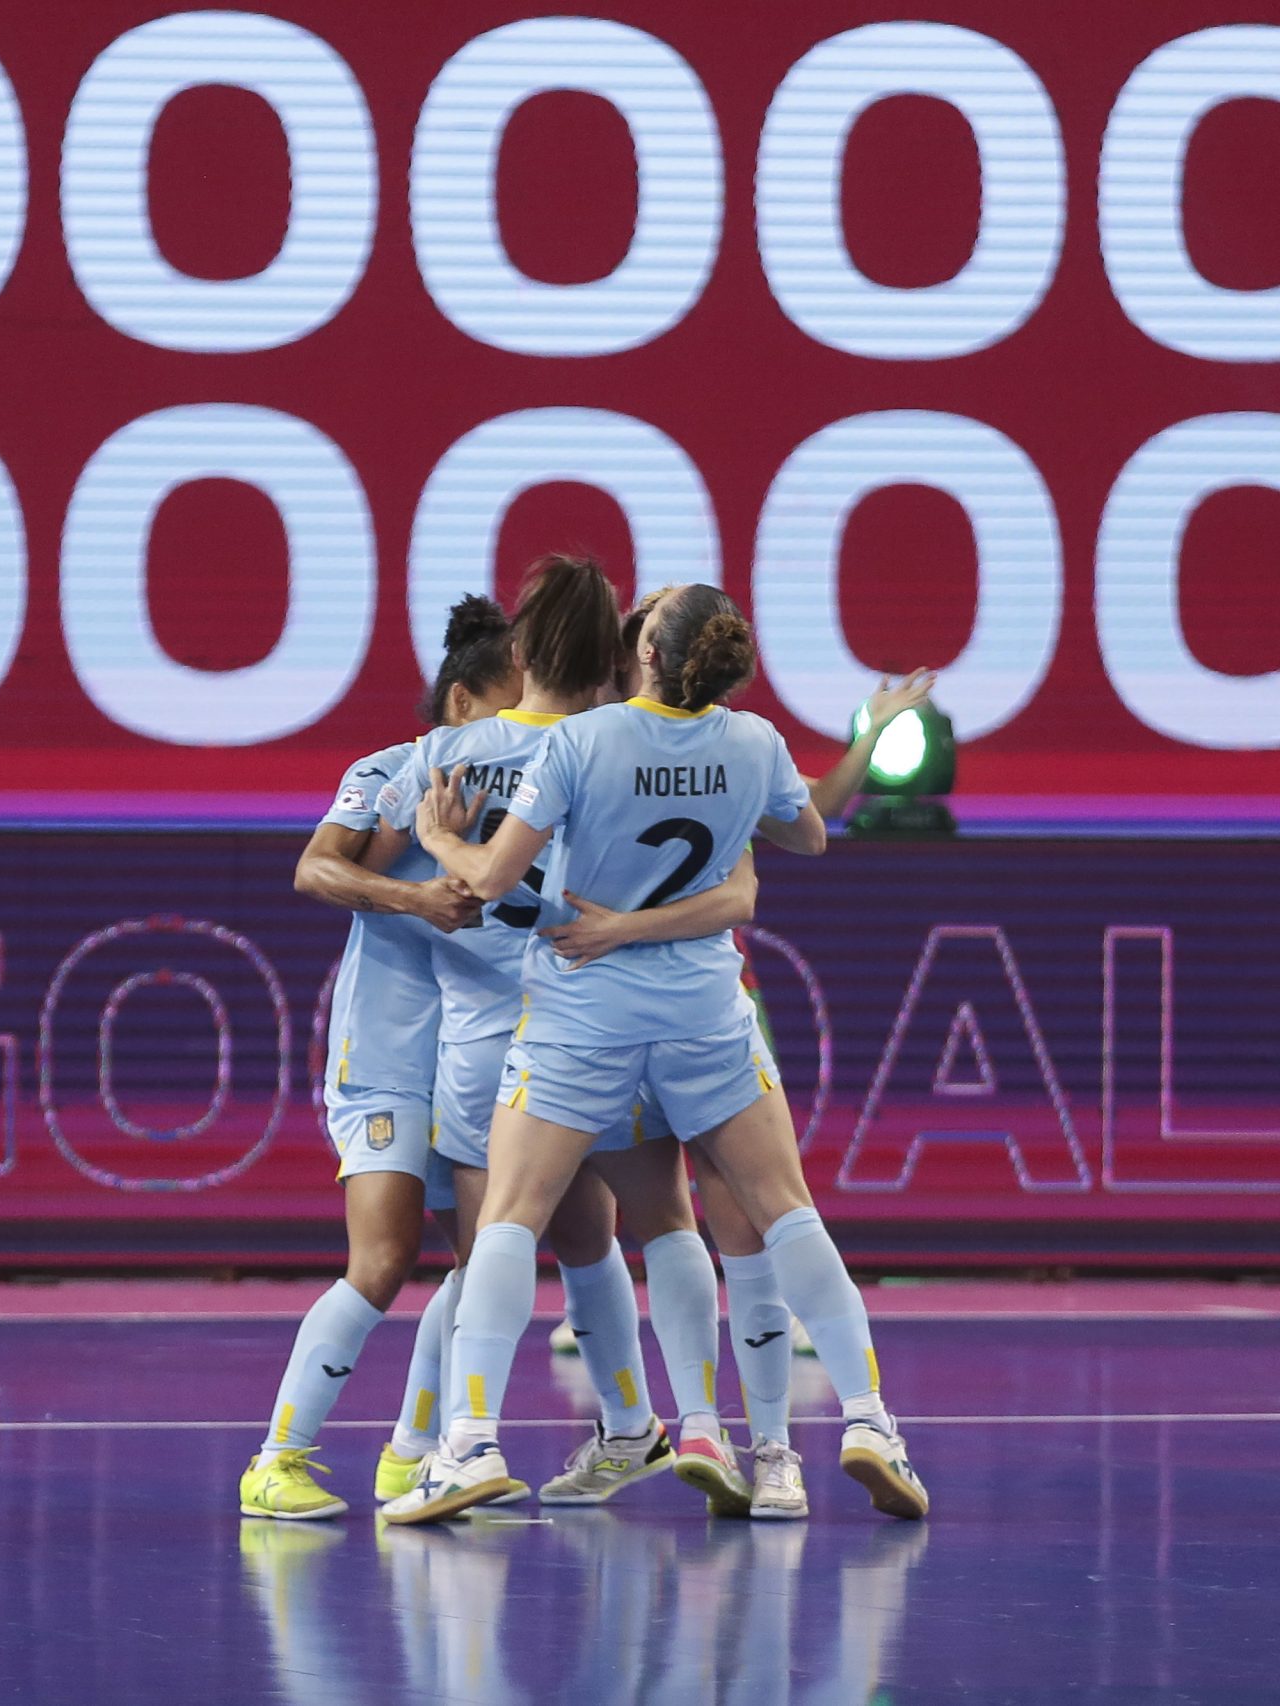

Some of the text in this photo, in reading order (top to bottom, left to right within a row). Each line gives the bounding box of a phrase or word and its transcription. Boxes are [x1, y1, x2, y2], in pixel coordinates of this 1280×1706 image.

[464, 763, 524, 799] MAR
[634, 764, 728, 797] NOELIA
[633, 817, 715, 913] 2
